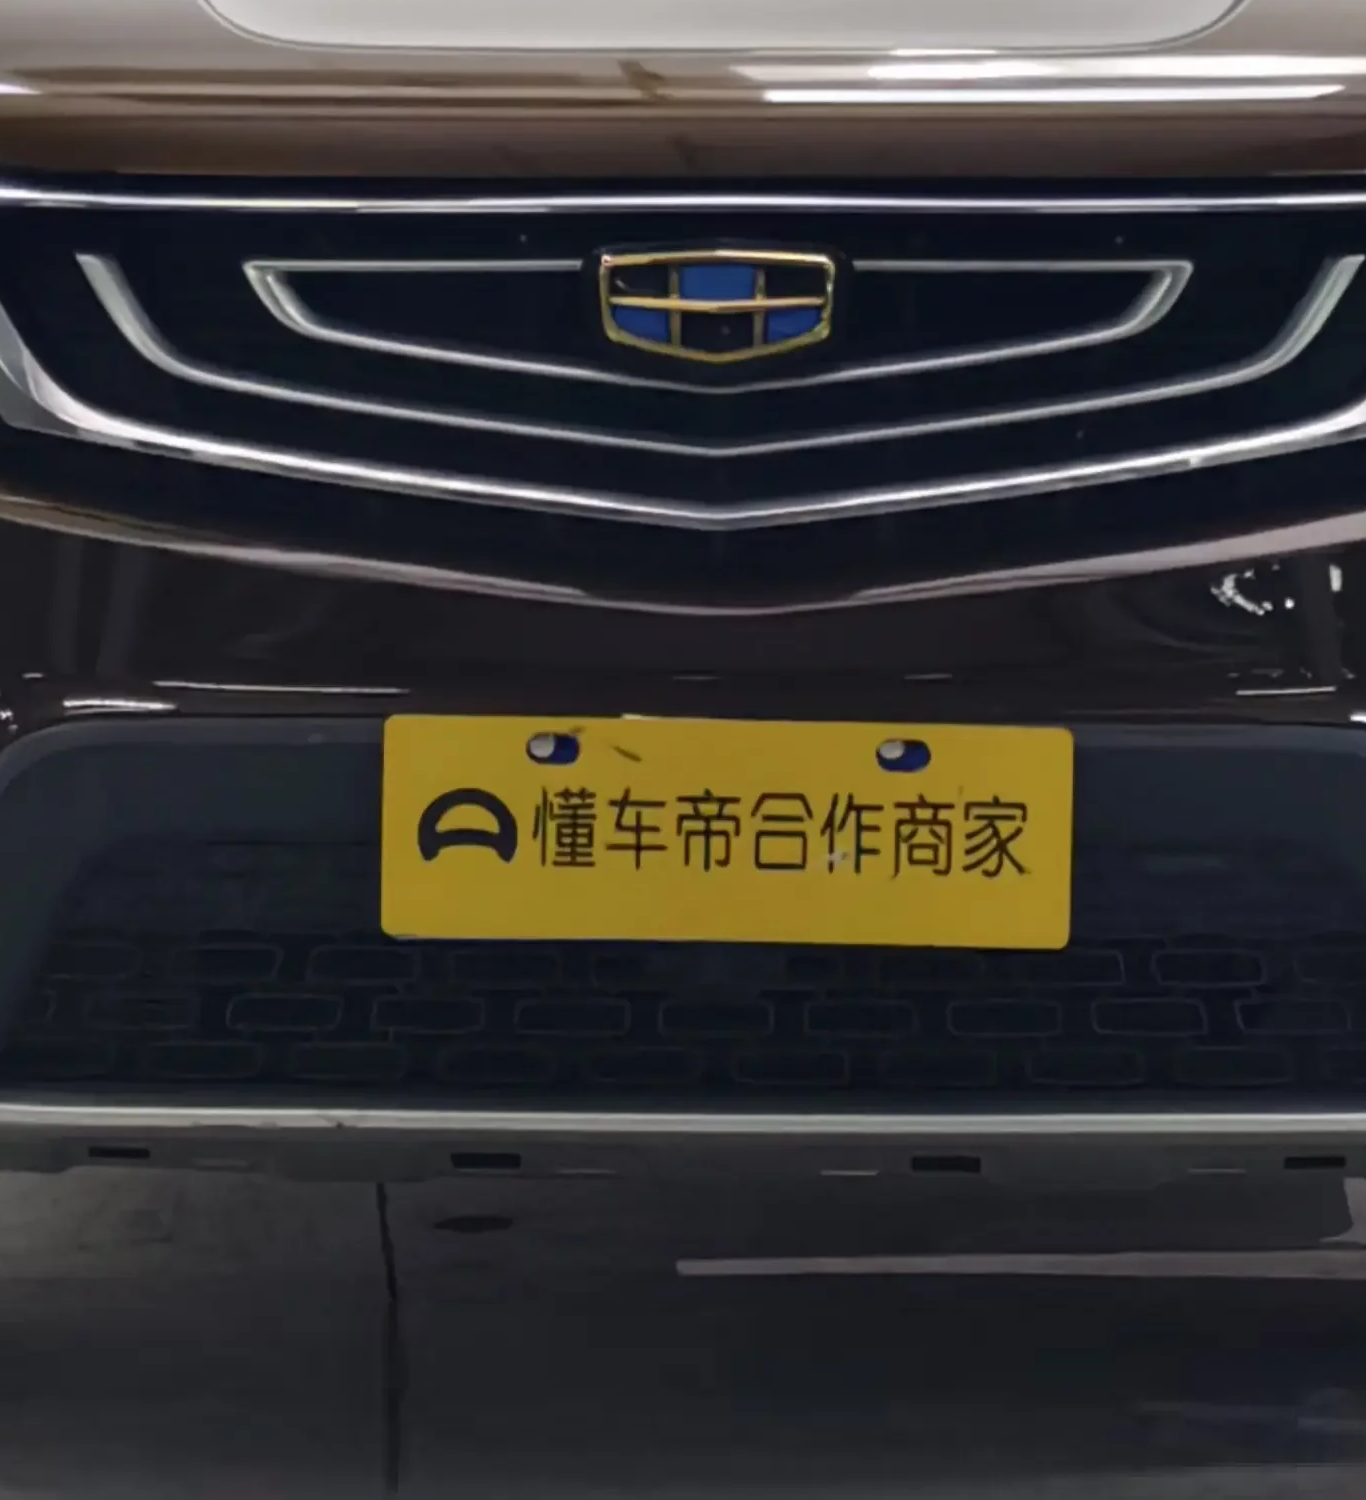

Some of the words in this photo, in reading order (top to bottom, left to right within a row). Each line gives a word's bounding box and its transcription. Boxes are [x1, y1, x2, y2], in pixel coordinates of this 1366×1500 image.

[533, 786, 1031, 879] 懂车帝合作商家
